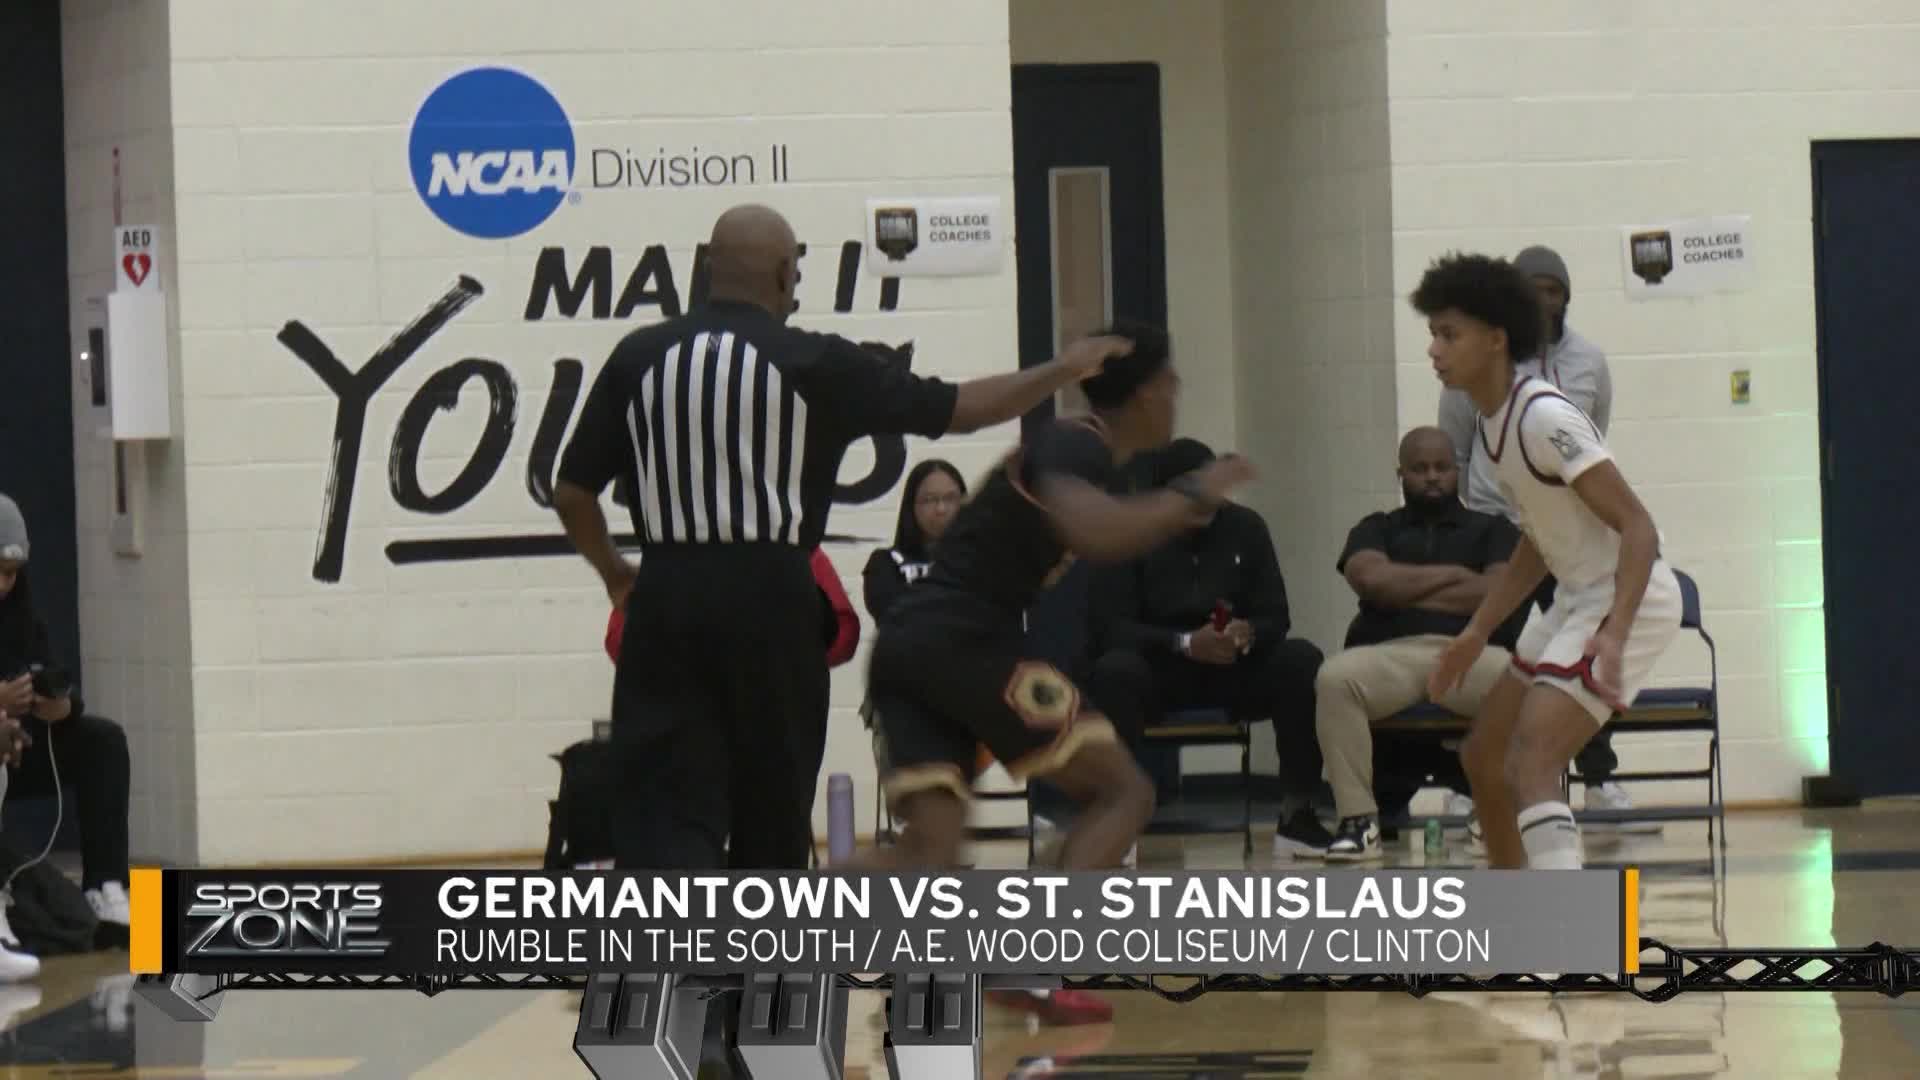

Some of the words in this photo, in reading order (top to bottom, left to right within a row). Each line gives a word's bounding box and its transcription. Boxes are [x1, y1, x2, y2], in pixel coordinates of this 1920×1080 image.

[427, 149, 570, 197] NCAA
[591, 147, 755, 188] Division
[929, 215, 990, 226] COLLEGE
[123, 230, 151, 247] AED
[929, 231, 991, 241] COACHES
[1683, 233, 1742, 248] COLLEGE
[1683, 248, 1744, 264] COACHES
[524, 243, 806, 320] MA
